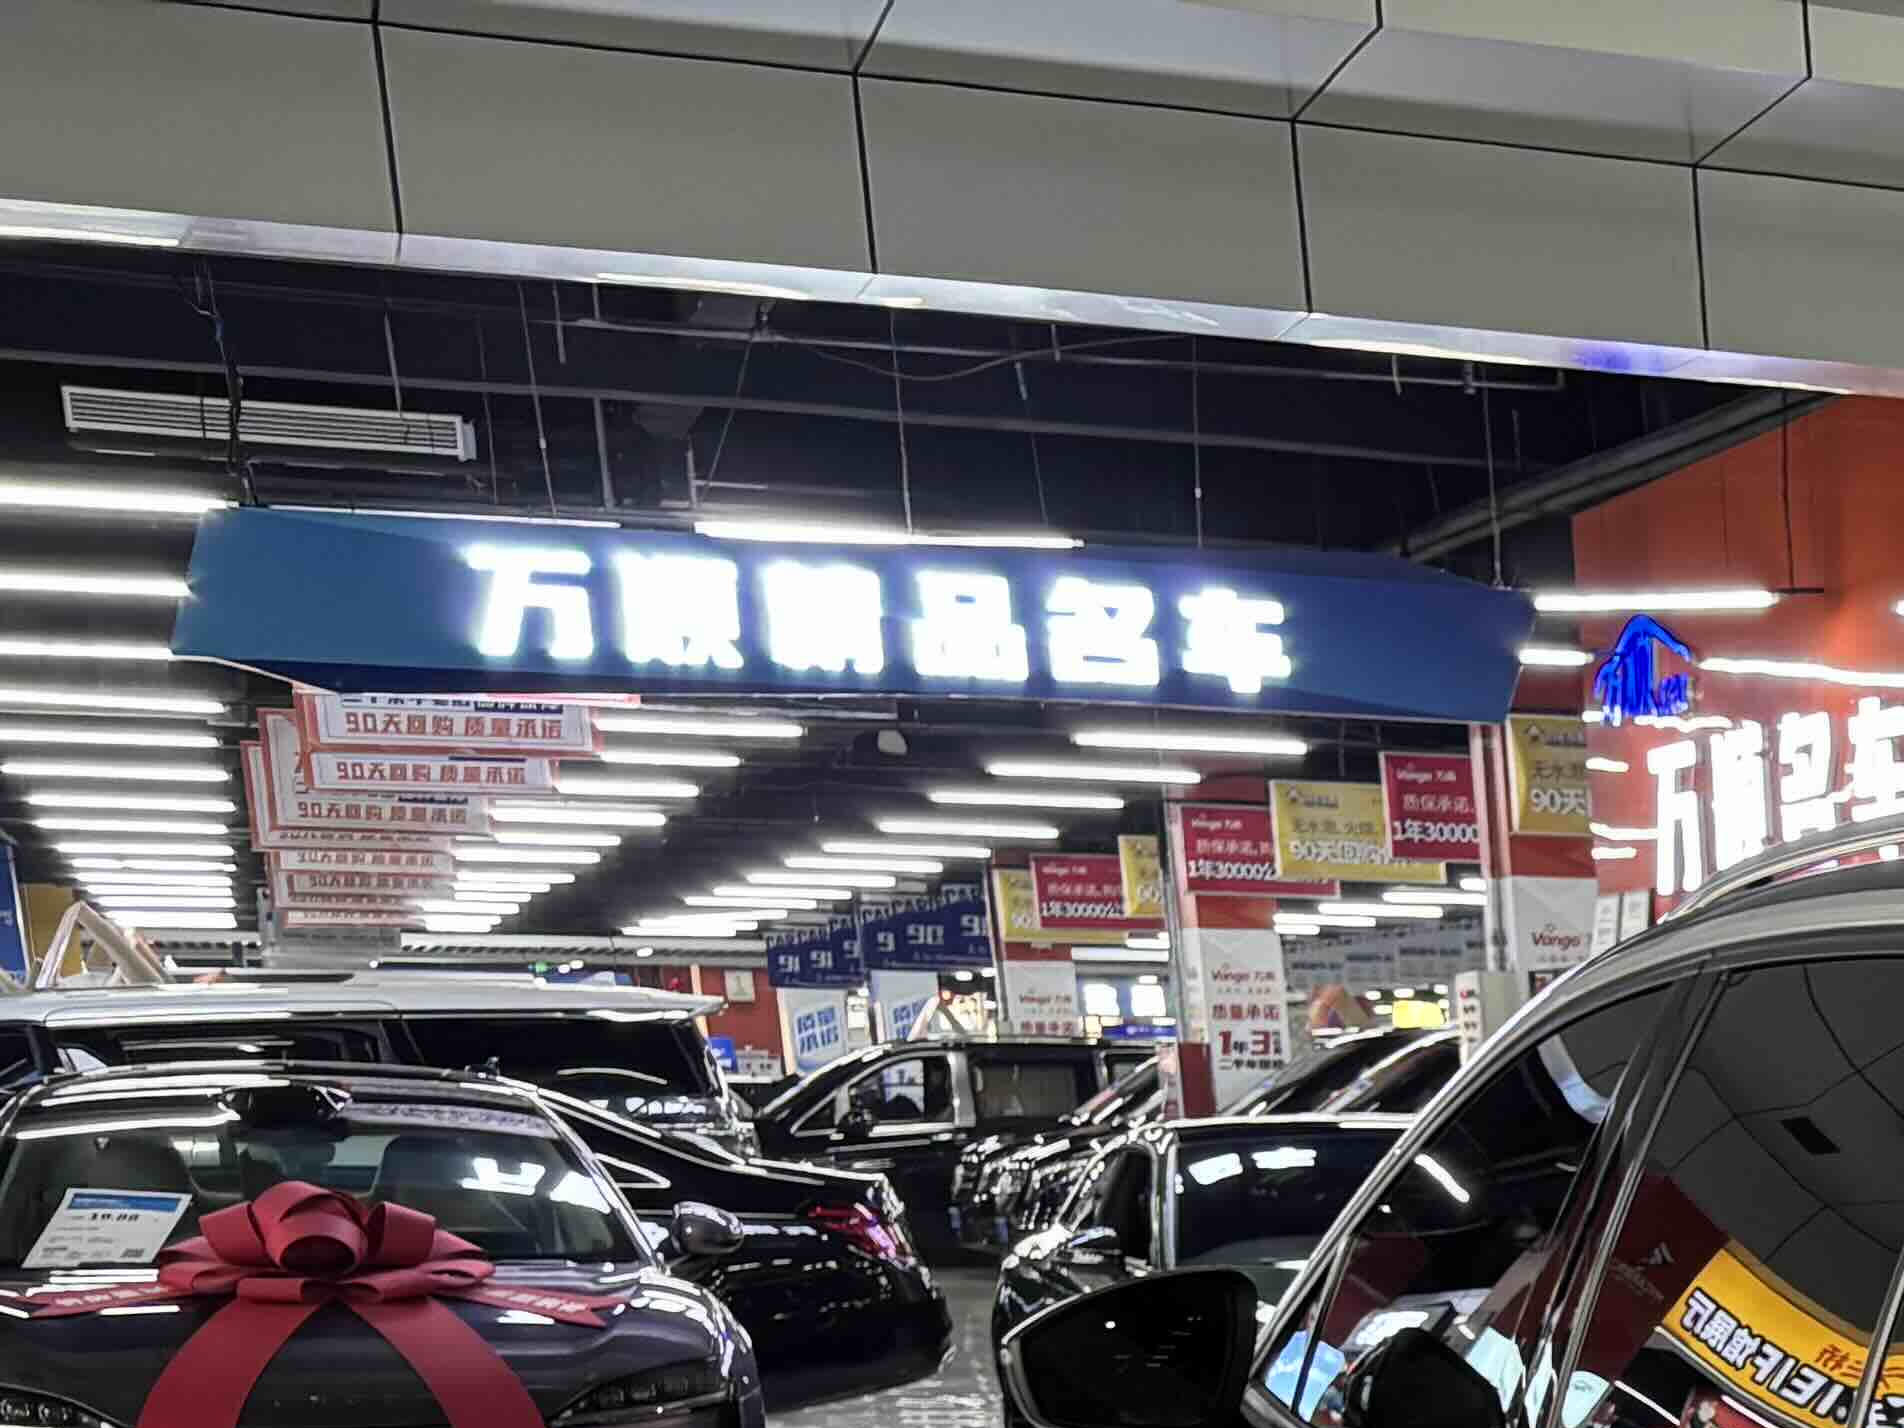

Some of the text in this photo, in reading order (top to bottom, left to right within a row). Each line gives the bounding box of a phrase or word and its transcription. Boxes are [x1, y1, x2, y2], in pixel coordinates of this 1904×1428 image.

[463, 544, 1291, 693] 万顺精品名车
